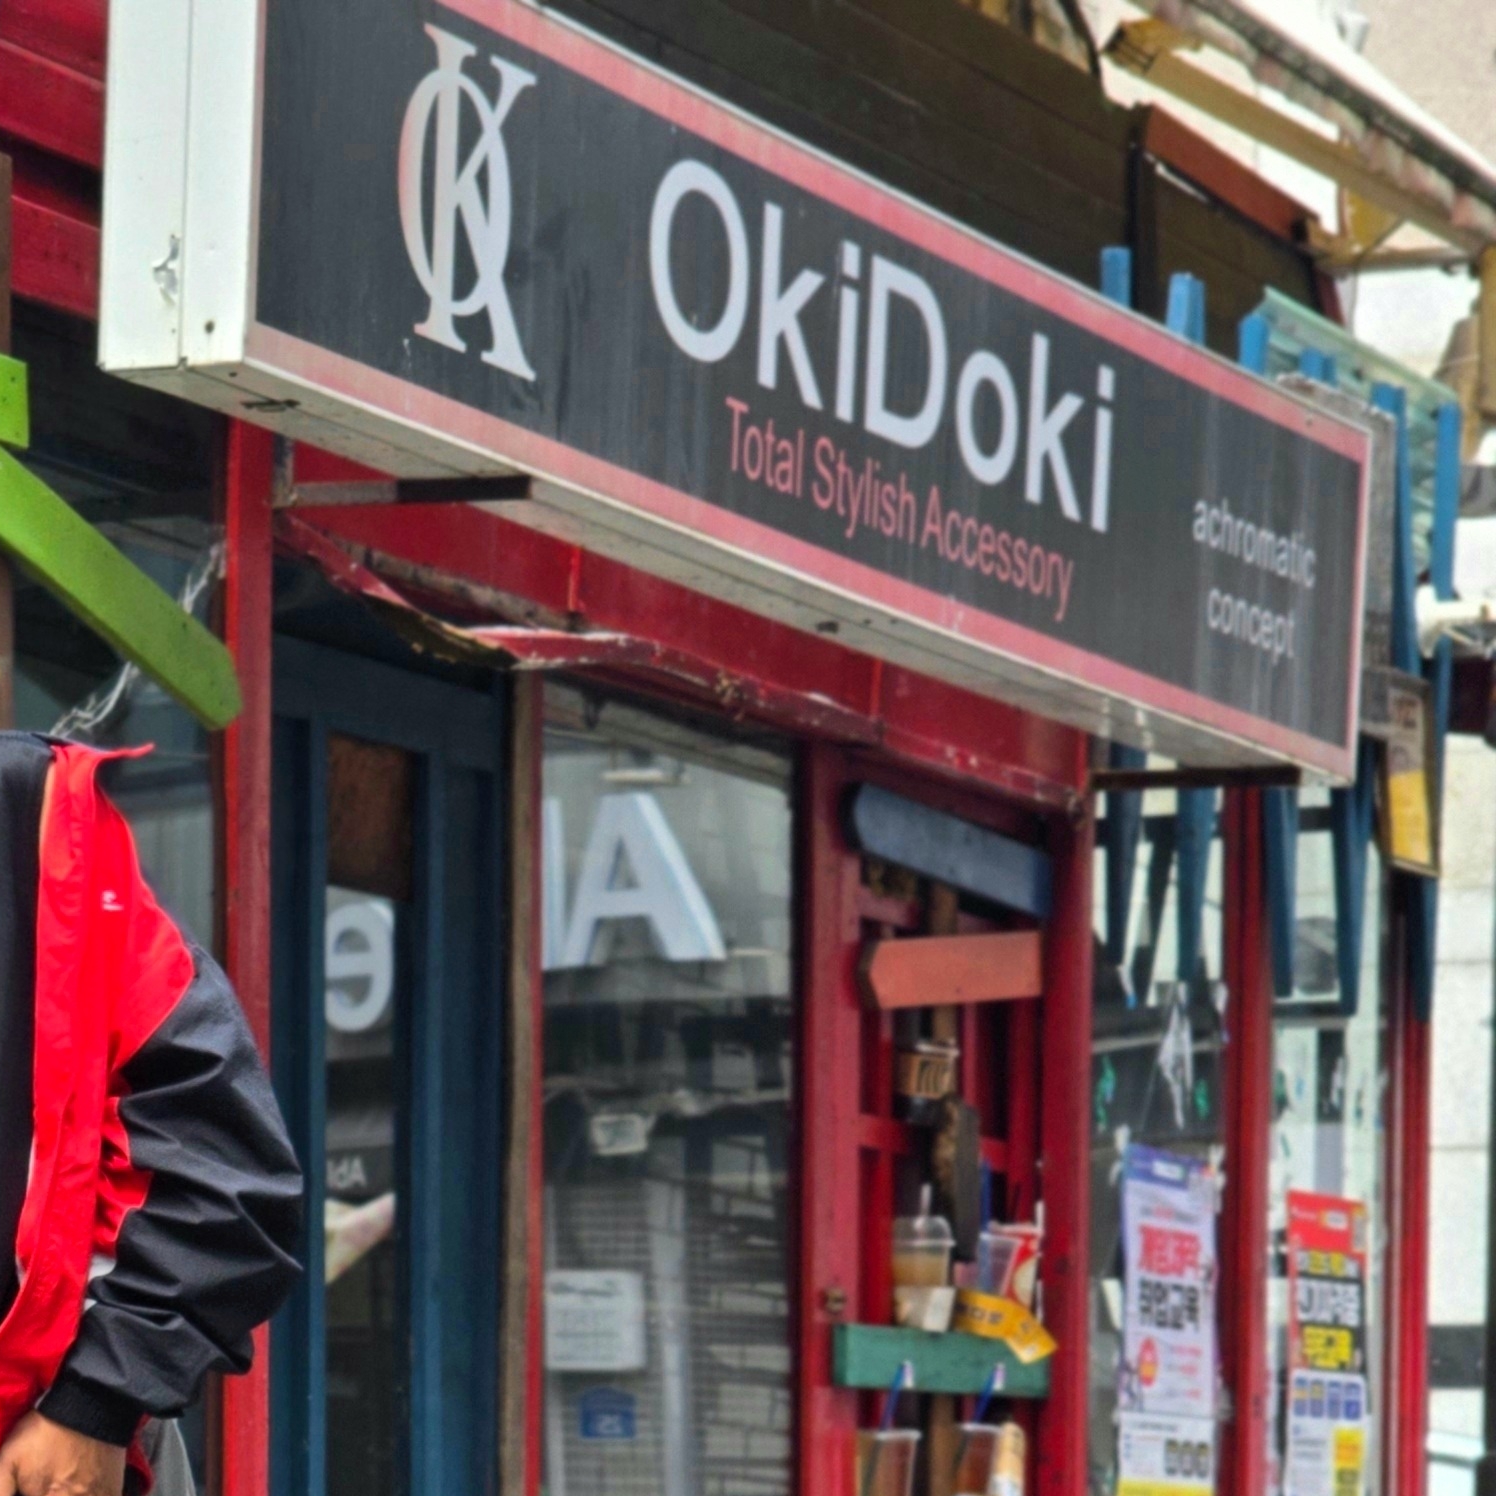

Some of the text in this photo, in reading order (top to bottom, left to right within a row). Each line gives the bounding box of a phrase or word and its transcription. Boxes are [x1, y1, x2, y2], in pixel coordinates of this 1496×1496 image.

[649, 158, 1116, 533] OkiDoki
[725, 396, 1075, 623] Total Stylish Accessory
[1192, 498, 1317, 589] achromatic
[1207, 588, 1295, 666] concept
